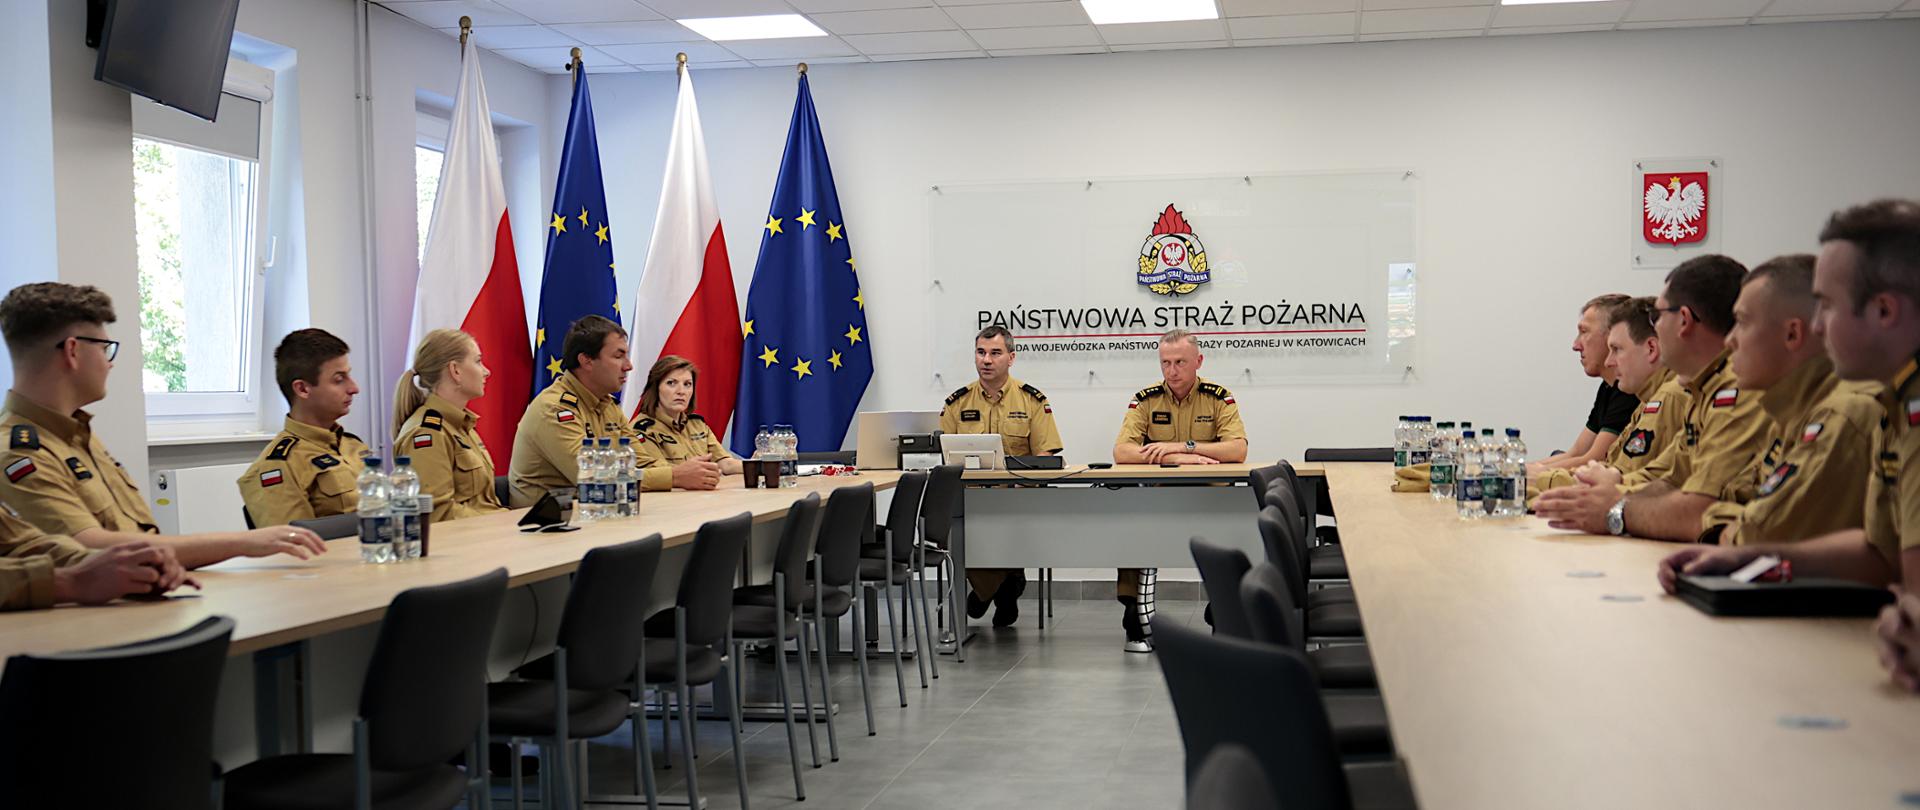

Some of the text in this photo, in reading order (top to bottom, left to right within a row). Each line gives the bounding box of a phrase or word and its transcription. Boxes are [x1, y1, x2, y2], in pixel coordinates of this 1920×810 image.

[978, 299, 1366, 331] PAŃSTWOWA STRAŻ POŻARNA
[1031, 340, 1106, 352] WOJEWÓDZKA
[1108, 340, 1159, 351] PAŃSTWO
[1283, 338, 1294, 348] W
[1296, 337, 1366, 348] KATOWICACH
